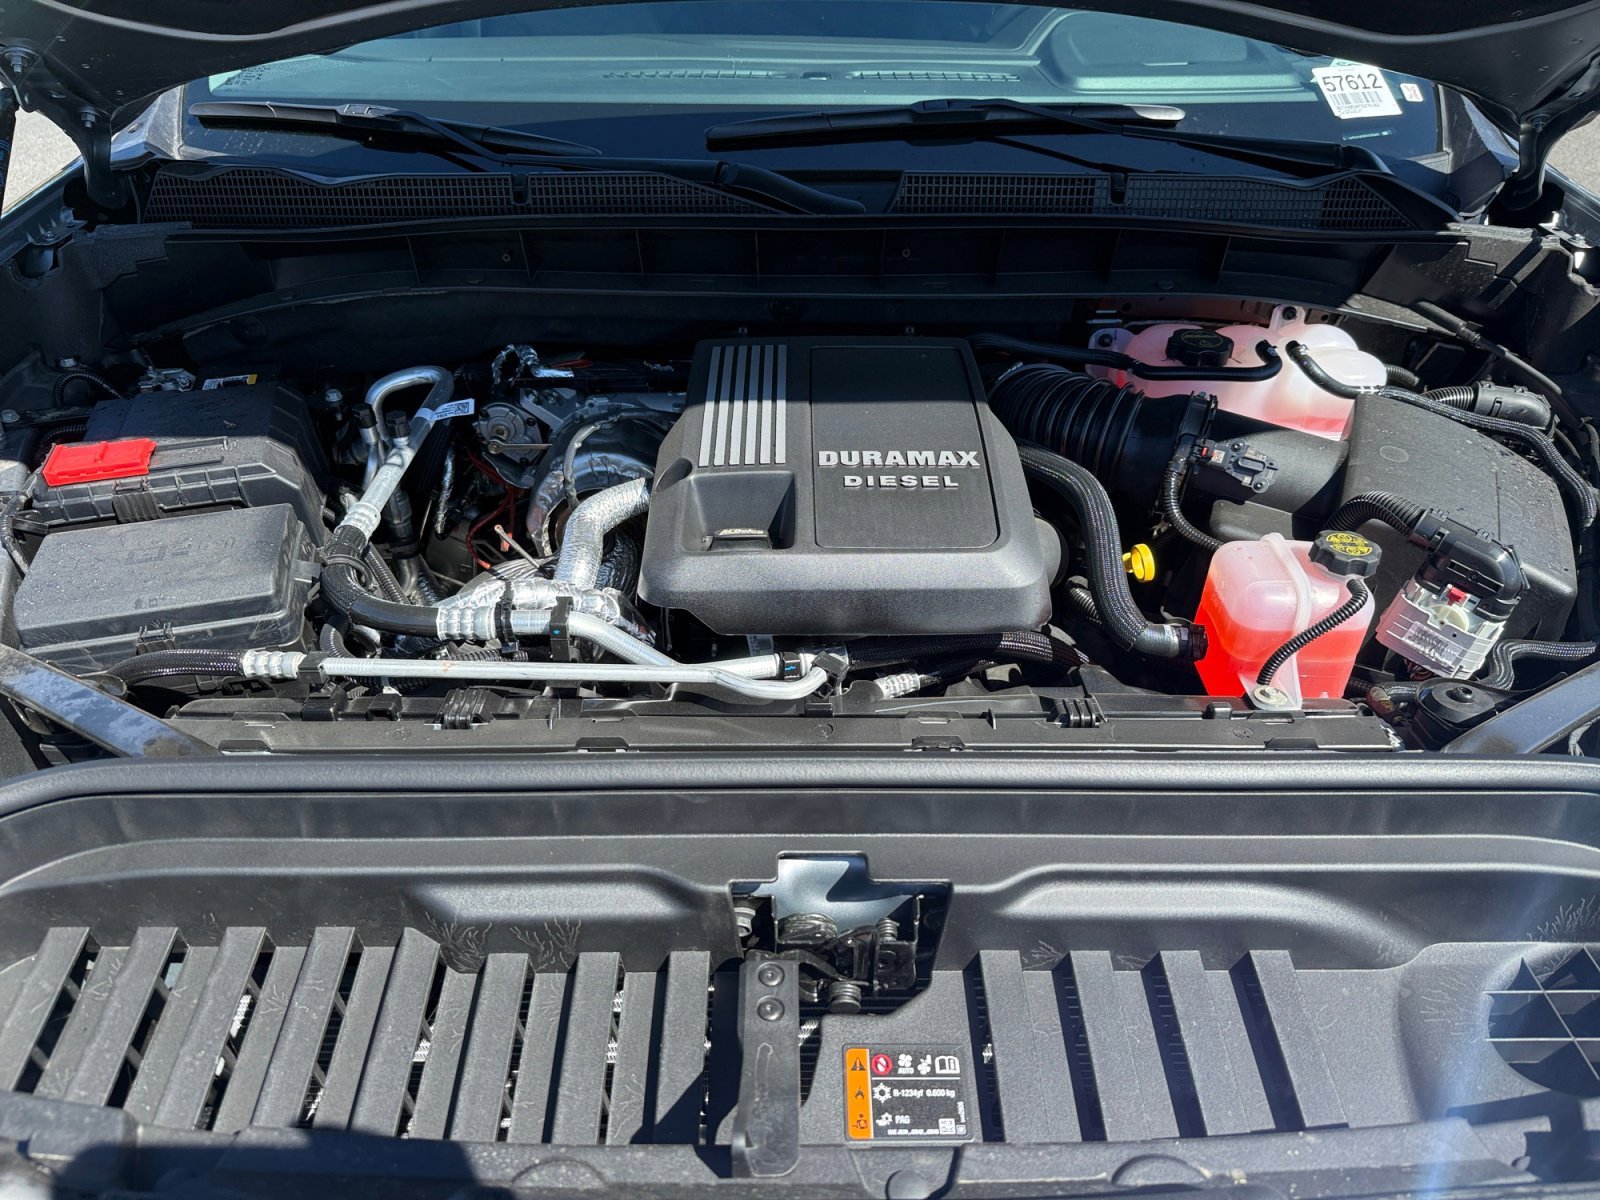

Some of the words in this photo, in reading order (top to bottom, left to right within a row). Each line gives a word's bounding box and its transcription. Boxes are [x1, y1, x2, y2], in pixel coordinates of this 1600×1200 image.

[1322, 74, 1382, 92] 57612
[818, 450, 981, 468] DURAMAX
[843, 475, 959, 489] DIESEL
[946, 1089, 955, 1098] kg
[895, 1115, 910, 1124] PAG
